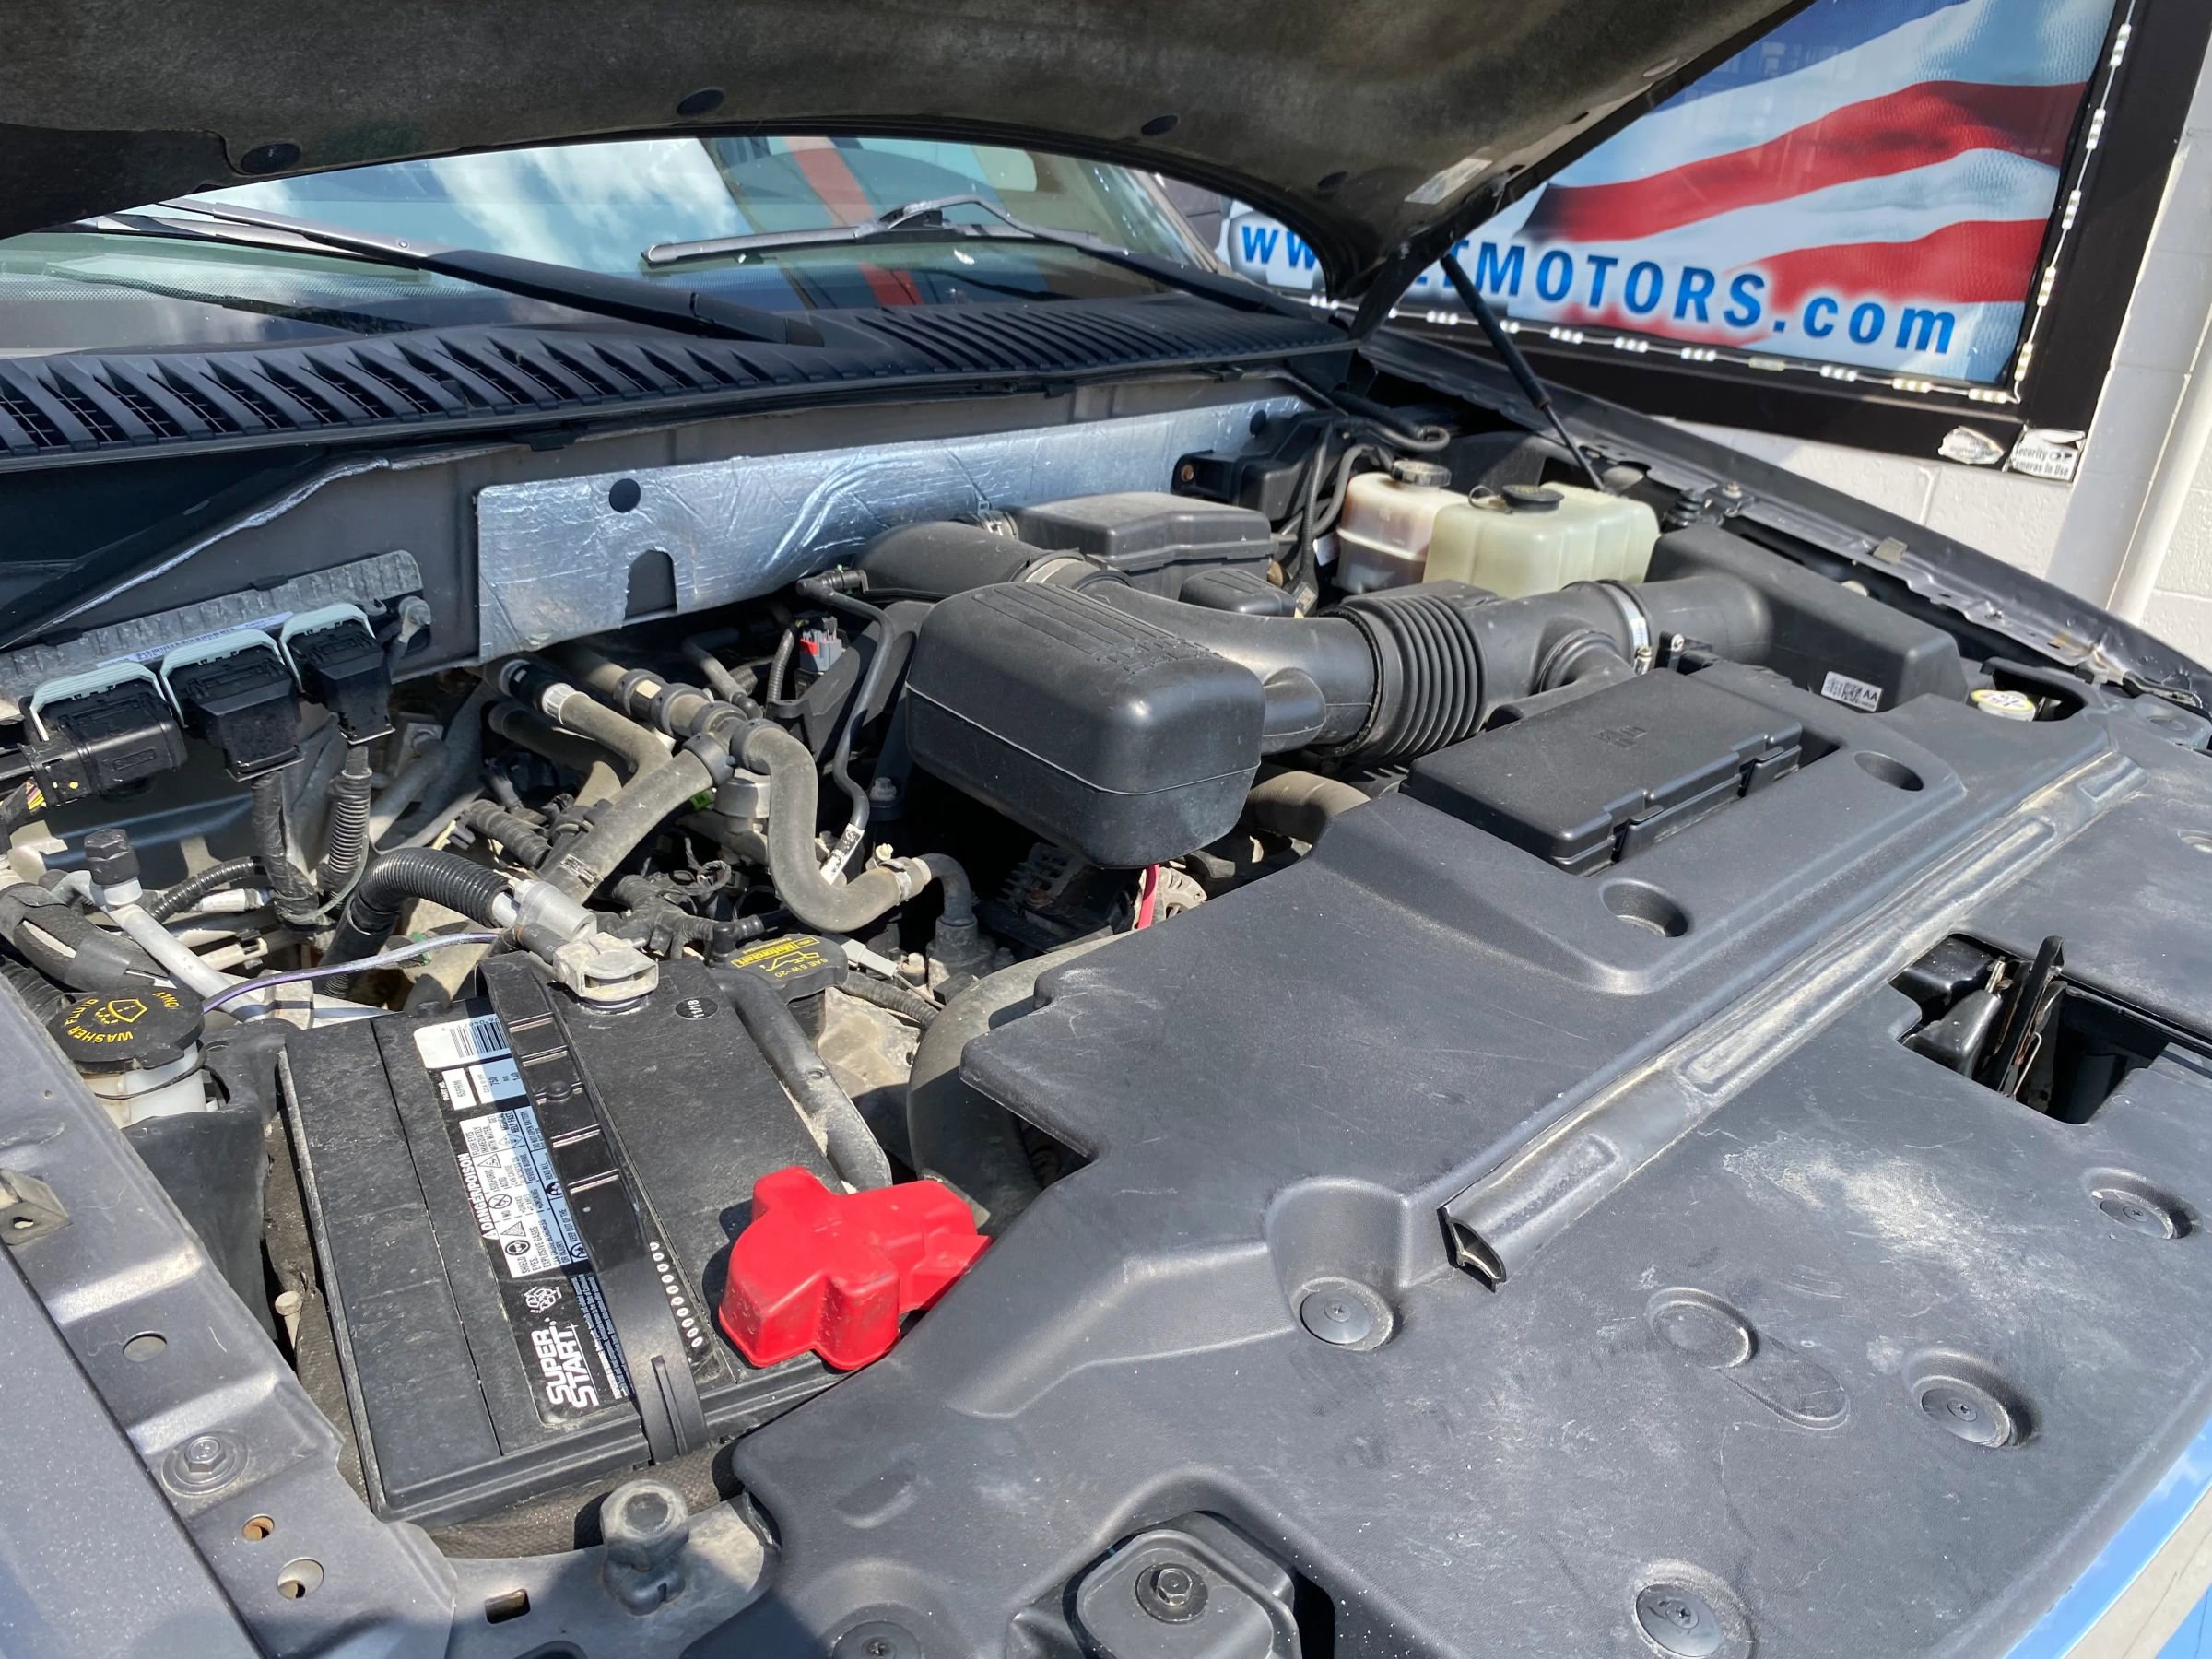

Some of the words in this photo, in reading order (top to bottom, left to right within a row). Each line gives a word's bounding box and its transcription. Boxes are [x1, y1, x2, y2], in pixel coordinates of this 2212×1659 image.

[2054, 464, 2069, 476] Use
[1862, 689, 1878, 702] AA
[774, 964, 808, 978] 5W-20
[806, 958, 828, 967] SAE
[152, 991, 180, 1009] ONLY
[64, 998, 99, 1026] FLUID
[686, 999, 707, 1019] 11/18
[67, 1026, 134, 1043] WASHER
[457, 1152, 495, 1230] DANGER/POISON
[529, 1226, 541, 1241] GASES
[535, 1241, 551, 1267] EXPLOSIVE
[517, 1257, 530, 1273] SHIELD
[531, 1329, 572, 1405] SUPER
[549, 1325, 599, 1408] START
